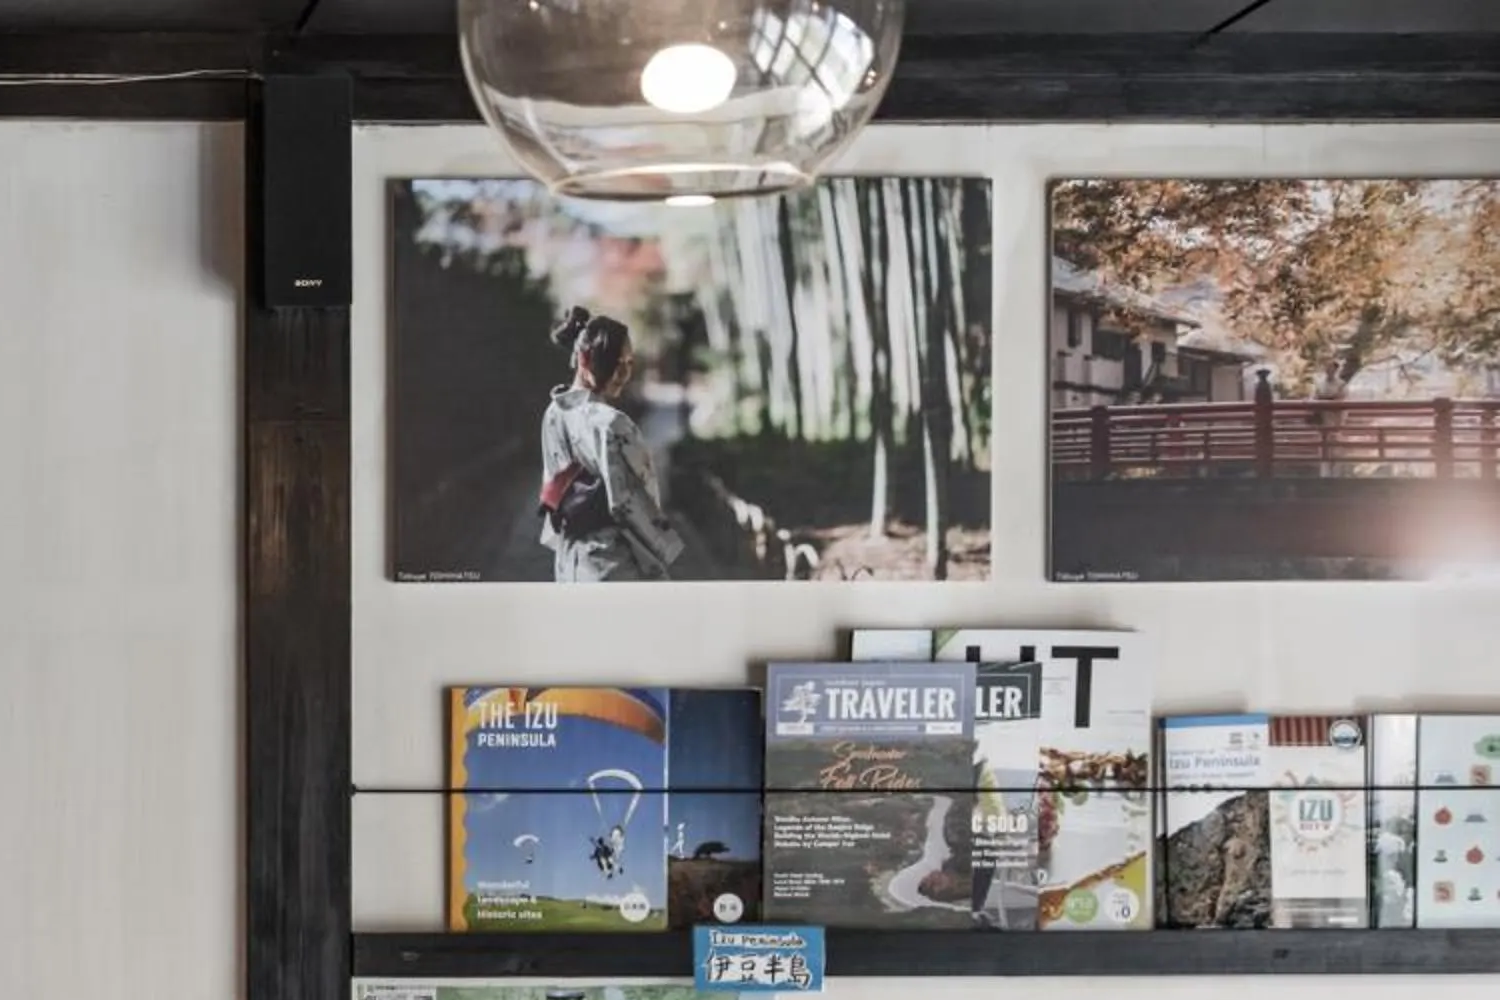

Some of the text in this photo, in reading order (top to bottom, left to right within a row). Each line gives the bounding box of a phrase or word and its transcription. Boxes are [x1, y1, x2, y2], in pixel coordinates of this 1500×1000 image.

[294, 279, 323, 287] SONY
[478, 700, 558, 729] THE IZU
[825, 687, 956, 719] TRAVELER
[975, 686, 1023, 718] LER
[477, 732, 557, 748] PENINSULA
[1299, 798, 1333, 821] IZU
[987, 814, 1028, 833] SOLO
[706, 952, 811, 987] 伊豆半島
